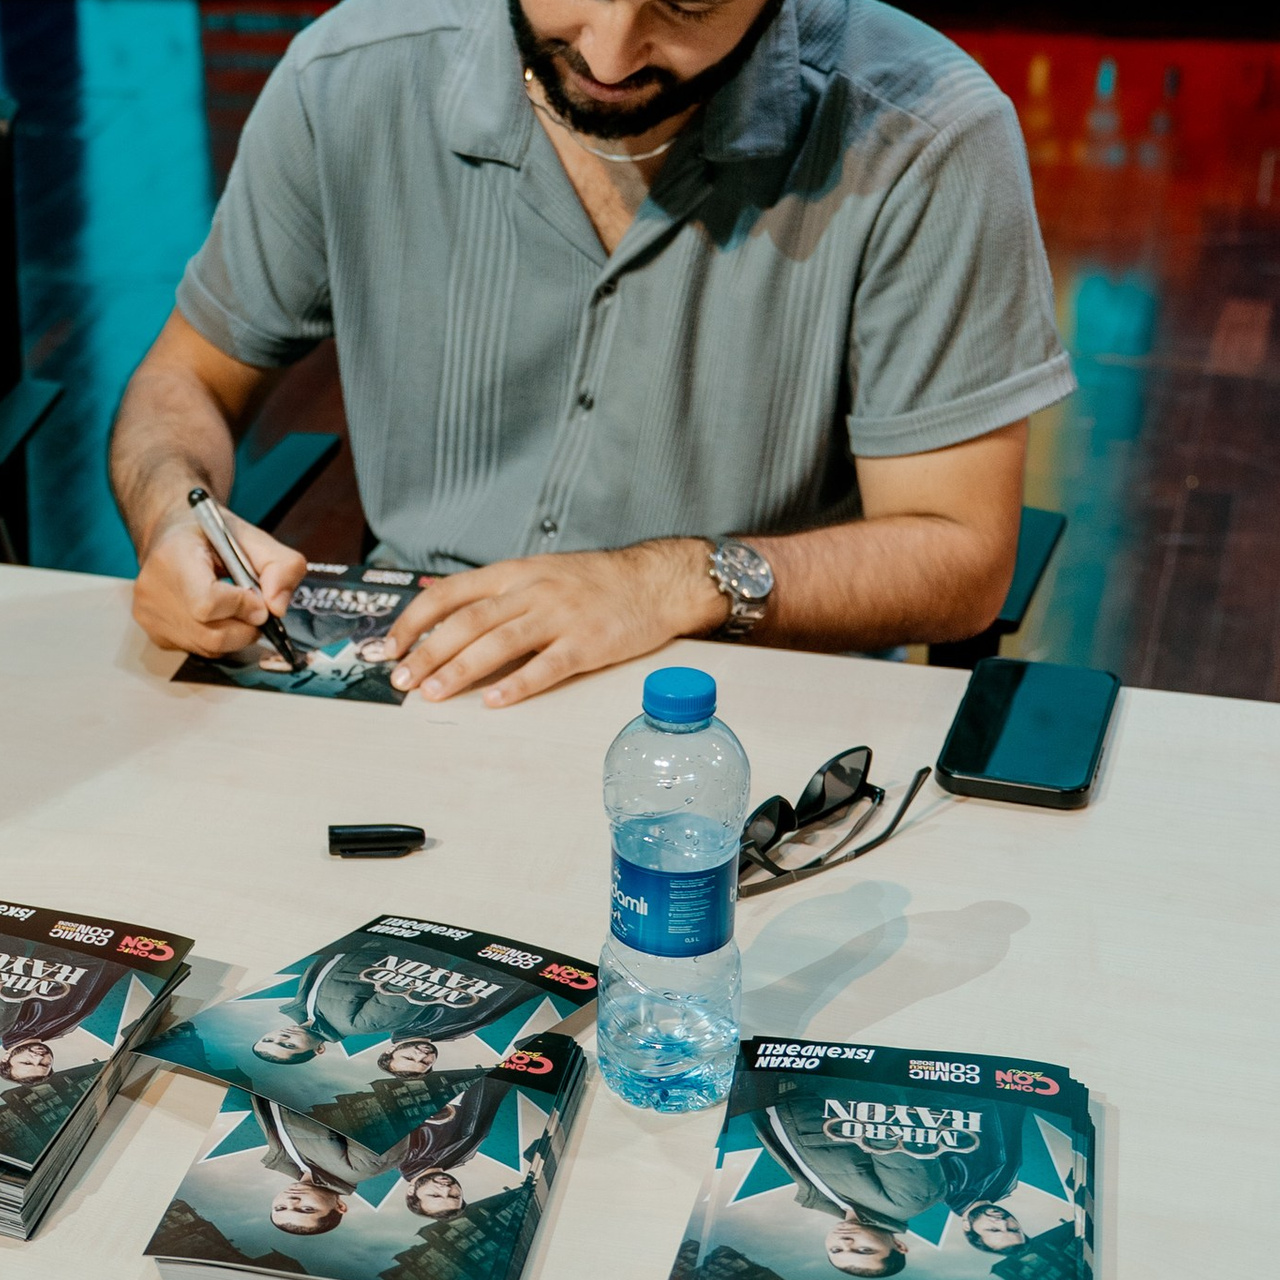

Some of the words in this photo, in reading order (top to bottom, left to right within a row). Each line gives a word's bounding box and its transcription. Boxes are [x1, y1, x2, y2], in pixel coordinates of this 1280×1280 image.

[48, 928, 109, 947] COMIC
[75, 923, 115, 940] CON
[366, 924, 421, 938] ORXAN
[476, 948, 535, 970] COMIC
[505, 946, 544, 964] CON
[370, 954, 504, 999] RAYON
[754, 1055, 821, 1070] ORXAN
[935, 1061, 981, 1075] CON
[908, 1069, 981, 1085] COMIC
[822, 1098, 983, 1134] RAYON
